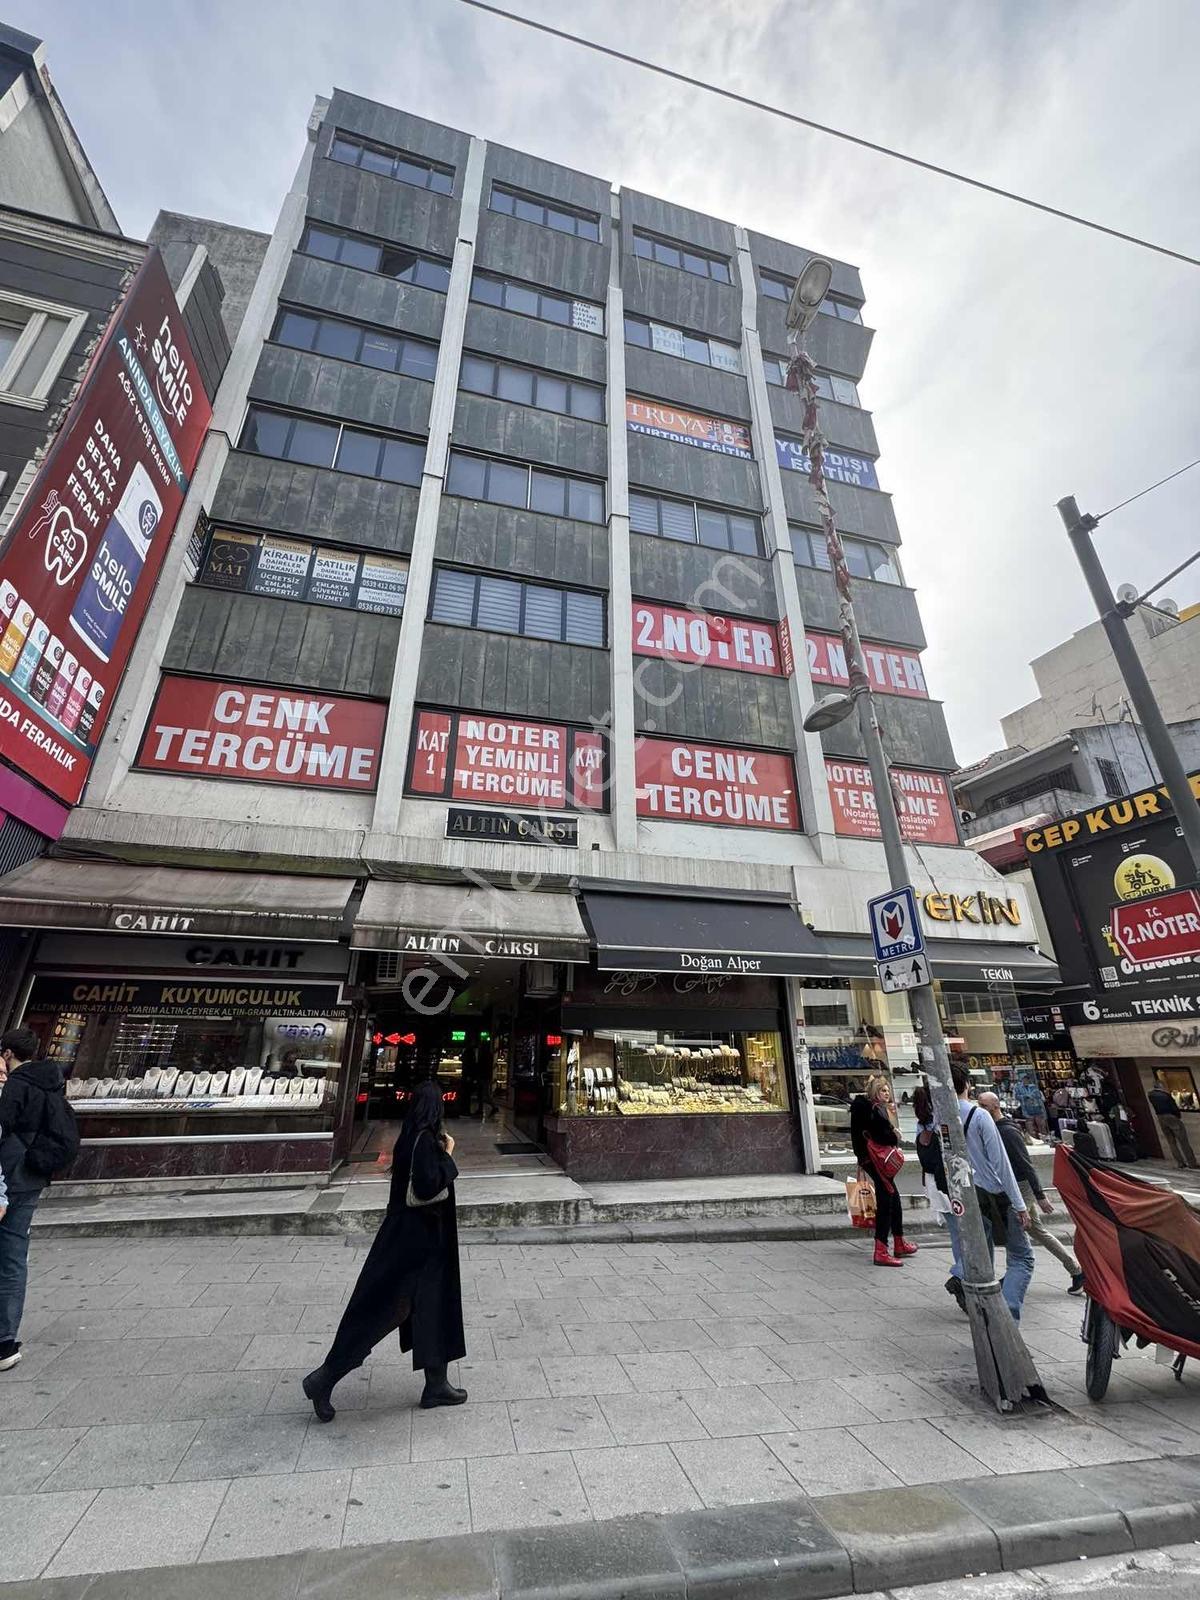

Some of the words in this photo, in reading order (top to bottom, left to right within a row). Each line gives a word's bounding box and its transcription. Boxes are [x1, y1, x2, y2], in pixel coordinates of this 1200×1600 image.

[159, 315, 193, 406] hello
[152, 338, 187, 427] SMILE
[118, 337, 152, 412] ANINDA
[151, 411, 183, 483] BEYAZLIK
[627, 401, 707, 433] TRUVA
[117, 371, 137, 406] AĞIZ
[151, 446, 171, 486] BAKIMI
[95, 418, 122, 471] DAHA
[86, 436, 117, 492] BEYAZ
[76, 455, 107, 506] DAHA
[67, 472, 100, 527] FERAH
[53, 535, 75, 568] CARE
[60, 528, 76, 551] 4D
[99, 541, 132, 596] hello
[263, 549, 306, 563] KİRALIK
[265, 559, 301, 568] DAİRELER
[316, 558, 356, 573] SATILIK
[92, 562, 127, 615] SMILE
[254, 584, 300, 597] EKSPERTİZ
[260, 572, 300, 584] ÜCRETSİZ
[264, 580, 293, 589] EMLAK
[315, 581, 349, 591] EMLAKTA
[804, 638, 927, 692] 2.NTER
[213, 690, 336, 735] CENK
[20, 718, 77, 772] FERAHLIK
[417, 729, 449, 753] KAT
[466, 719, 560, 750] NOTER
[153, 725, 376, 782] TERCÜME
[425, 753, 435, 775] 1
[575, 747, 602, 769] KAT
[671, 747, 758, 785] CENK
[458, 769, 563, 799] TERCÜME
[585, 769, 593, 790] 1
[644, 783, 791, 824] TERCÜME
[452, 815, 511, 835] ALTIN
[1025, 820, 1081, 853] CEP
[114, 913, 195, 931] CAHİT
[1145, 907, 1162, 918] T.C.
[1122, 912, 1200, 945] 2.NOTER
[405, 935, 461, 952] ALTIN
[680, 954, 723, 971] Doğan
[726, 957, 761, 972] Alper
[981, 968, 1014, 980] TEKİN
[73, 982, 140, 1002] CAHİT
[160, 987, 303, 1006] KUYUMCULUK
[1131, 994, 1195, 1015] TEKNİK
[160, 1006, 220, 1016] ALTIN-ÇEYREK
[221, 1008, 272, 1016] ALTIN-GRAM
[272, 1008, 319, 1017] ALTIN-ALTIN
[320, 1009, 346, 1017] ALINIR
[1083, 1000, 1100, 1020] 6
